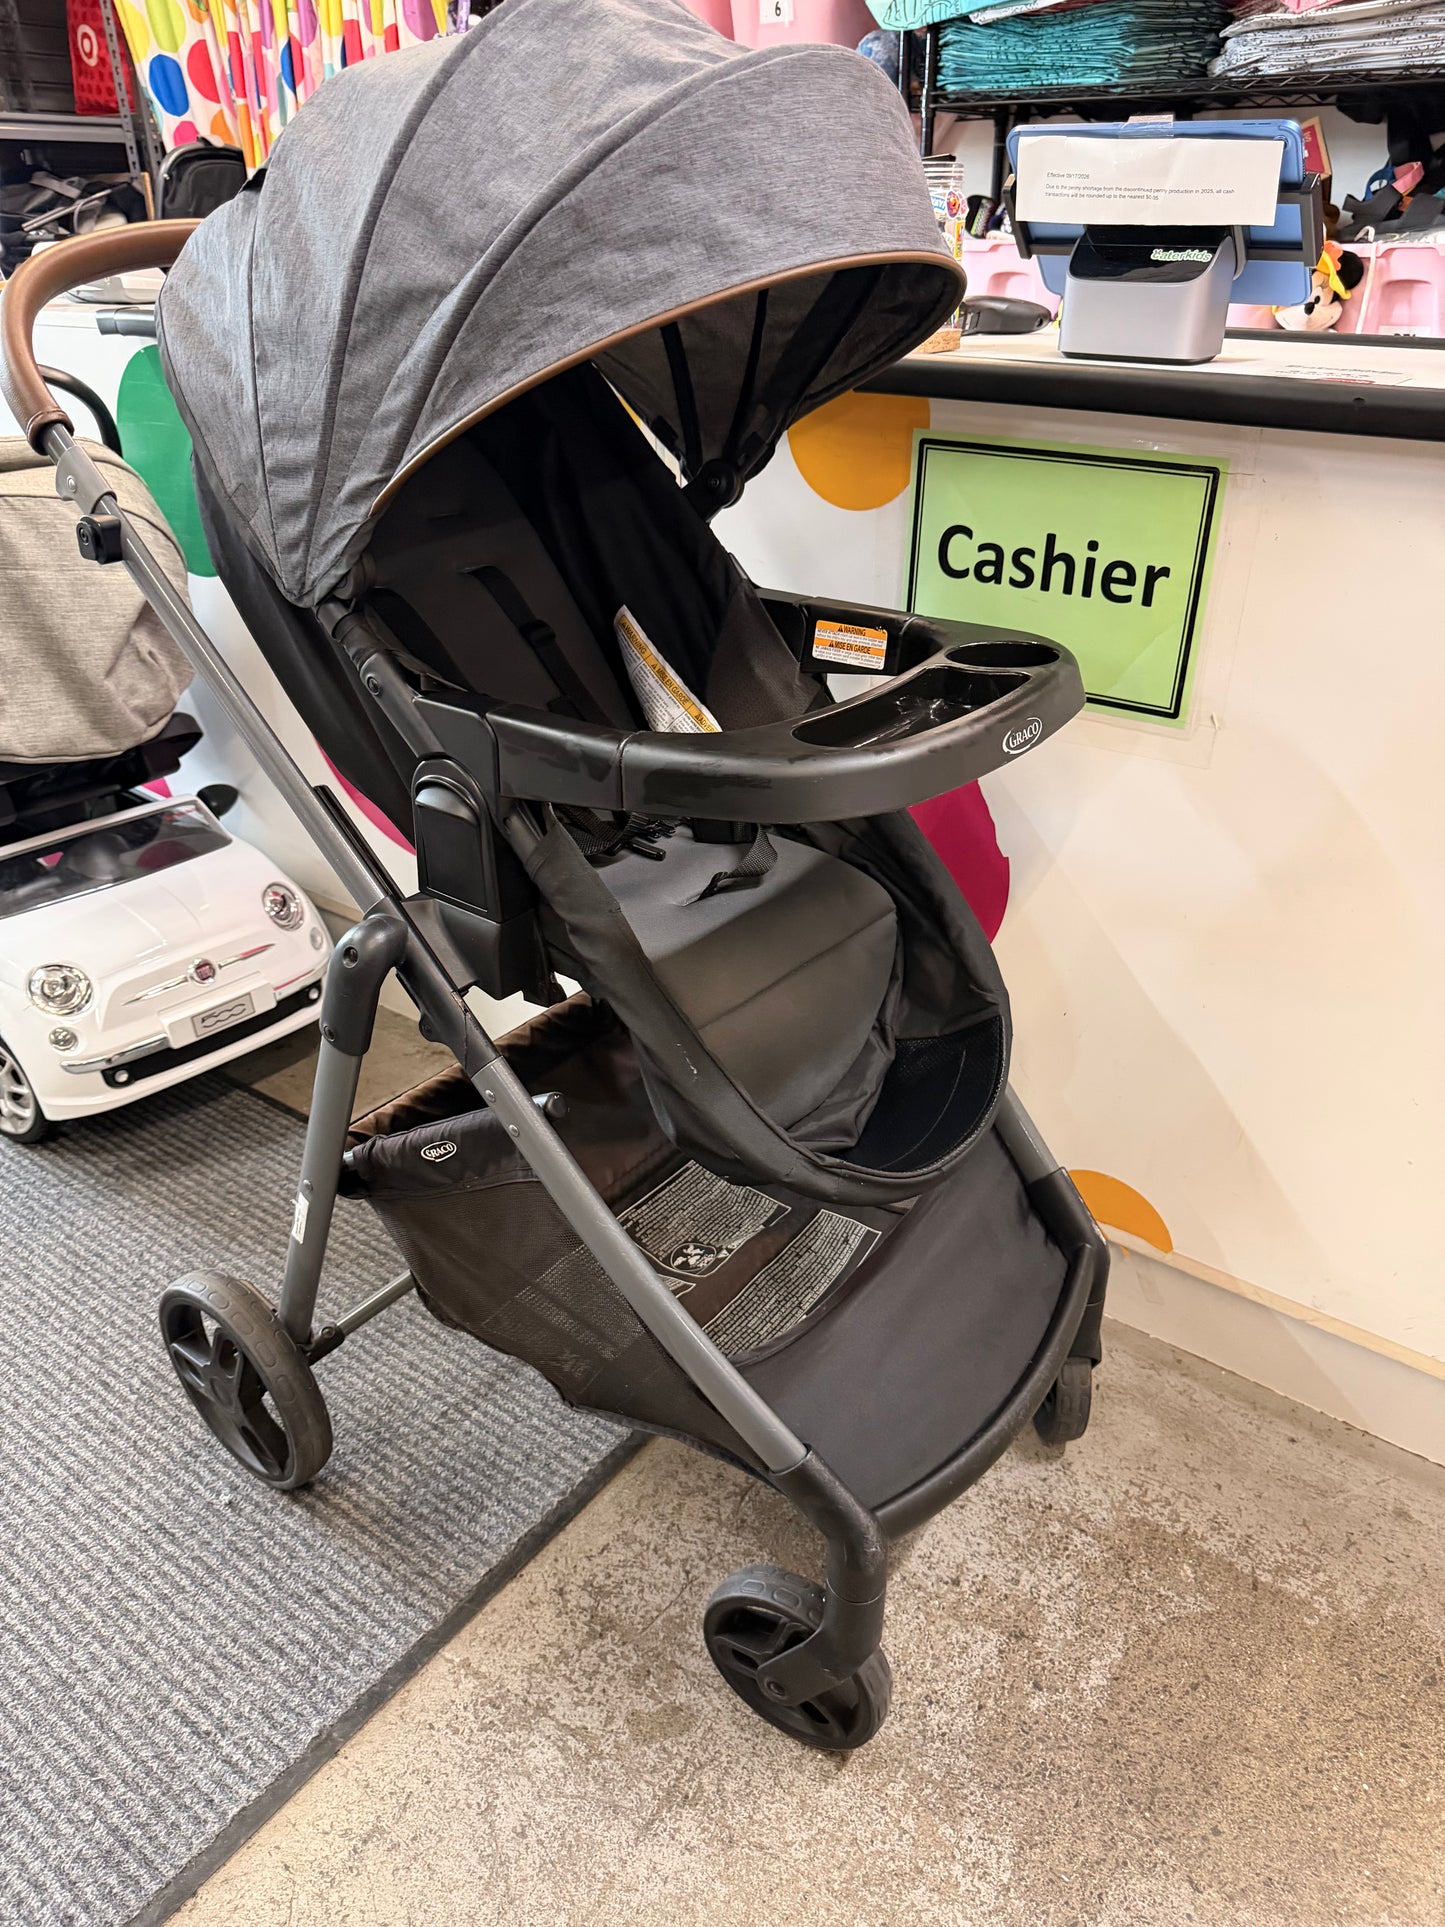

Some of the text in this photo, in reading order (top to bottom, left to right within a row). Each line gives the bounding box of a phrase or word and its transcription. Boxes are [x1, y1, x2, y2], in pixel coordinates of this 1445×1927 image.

[774, 0, 782, 17] 6
[938, 524, 1171, 608] Cashier
[625, 624, 647, 655] WARNING
[843, 625, 866, 637] WARNING
[854, 644, 872, 655] GARDE
[671, 685, 690, 705] GARDE
[1009, 722, 1039, 748] GRACO
[425, 1143, 454, 1158] GRACO
